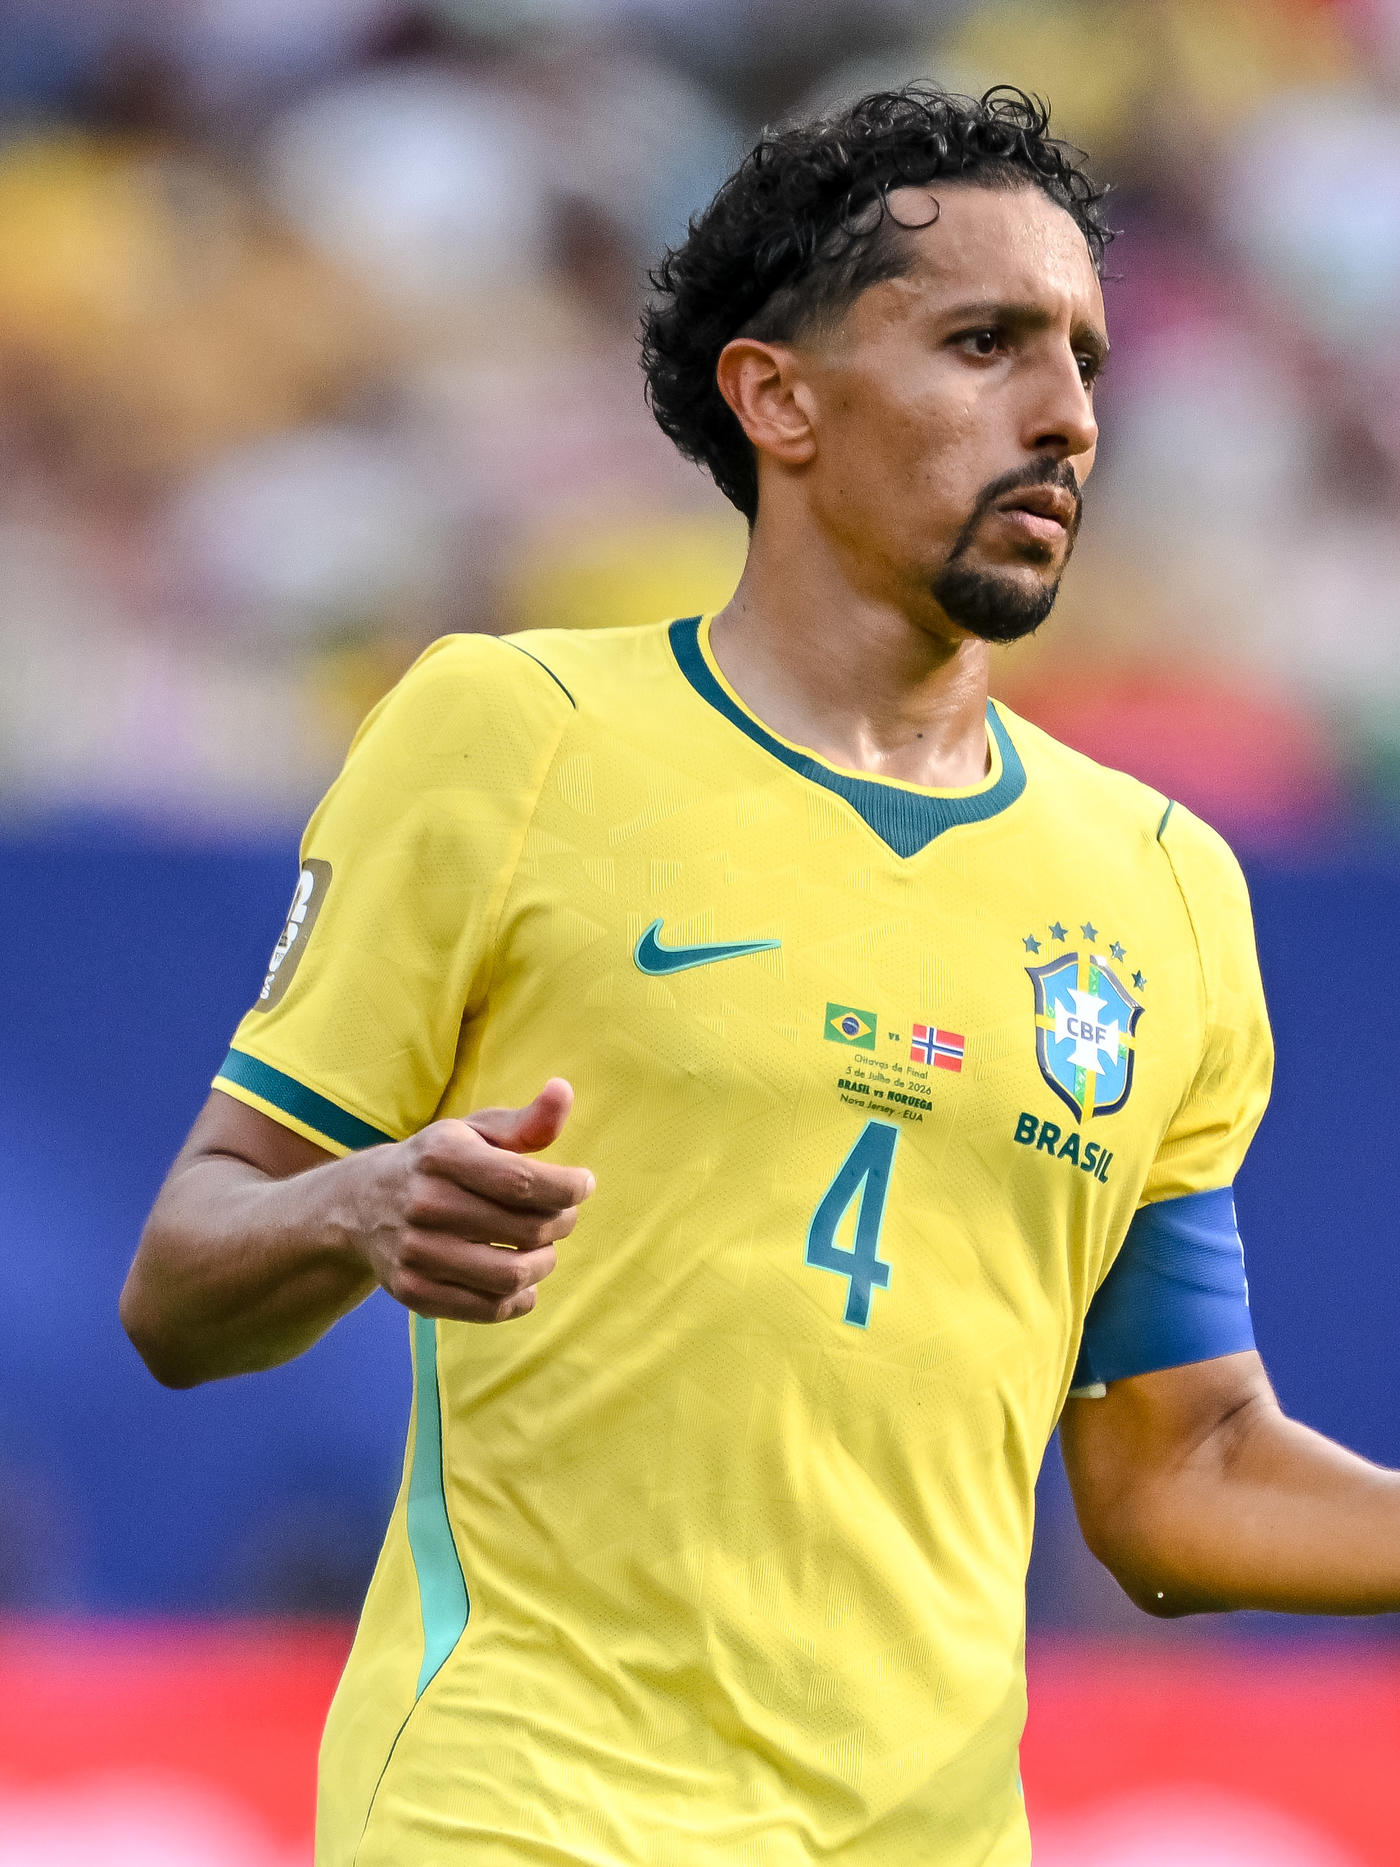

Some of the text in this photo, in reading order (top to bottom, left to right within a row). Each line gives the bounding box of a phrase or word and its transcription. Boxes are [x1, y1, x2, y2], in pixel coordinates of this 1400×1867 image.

[888, 1032, 900, 1041] vs
[1066, 1017, 1107, 1044] CBF
[846, 1066, 932, 1095] 5 de Julho de 2026
[854, 1054, 928, 1080] Oitavas de Final
[838, 1079, 933, 1111] BRASIL vs NORUEGA
[840, 1094, 865, 1107] Nova
[867, 1100, 896, 1117] Jersey
[903, 1109, 923, 1123] EUA
[1013, 1112, 1114, 1184] BRASIL
[804, 1118, 901, 1329] 4
